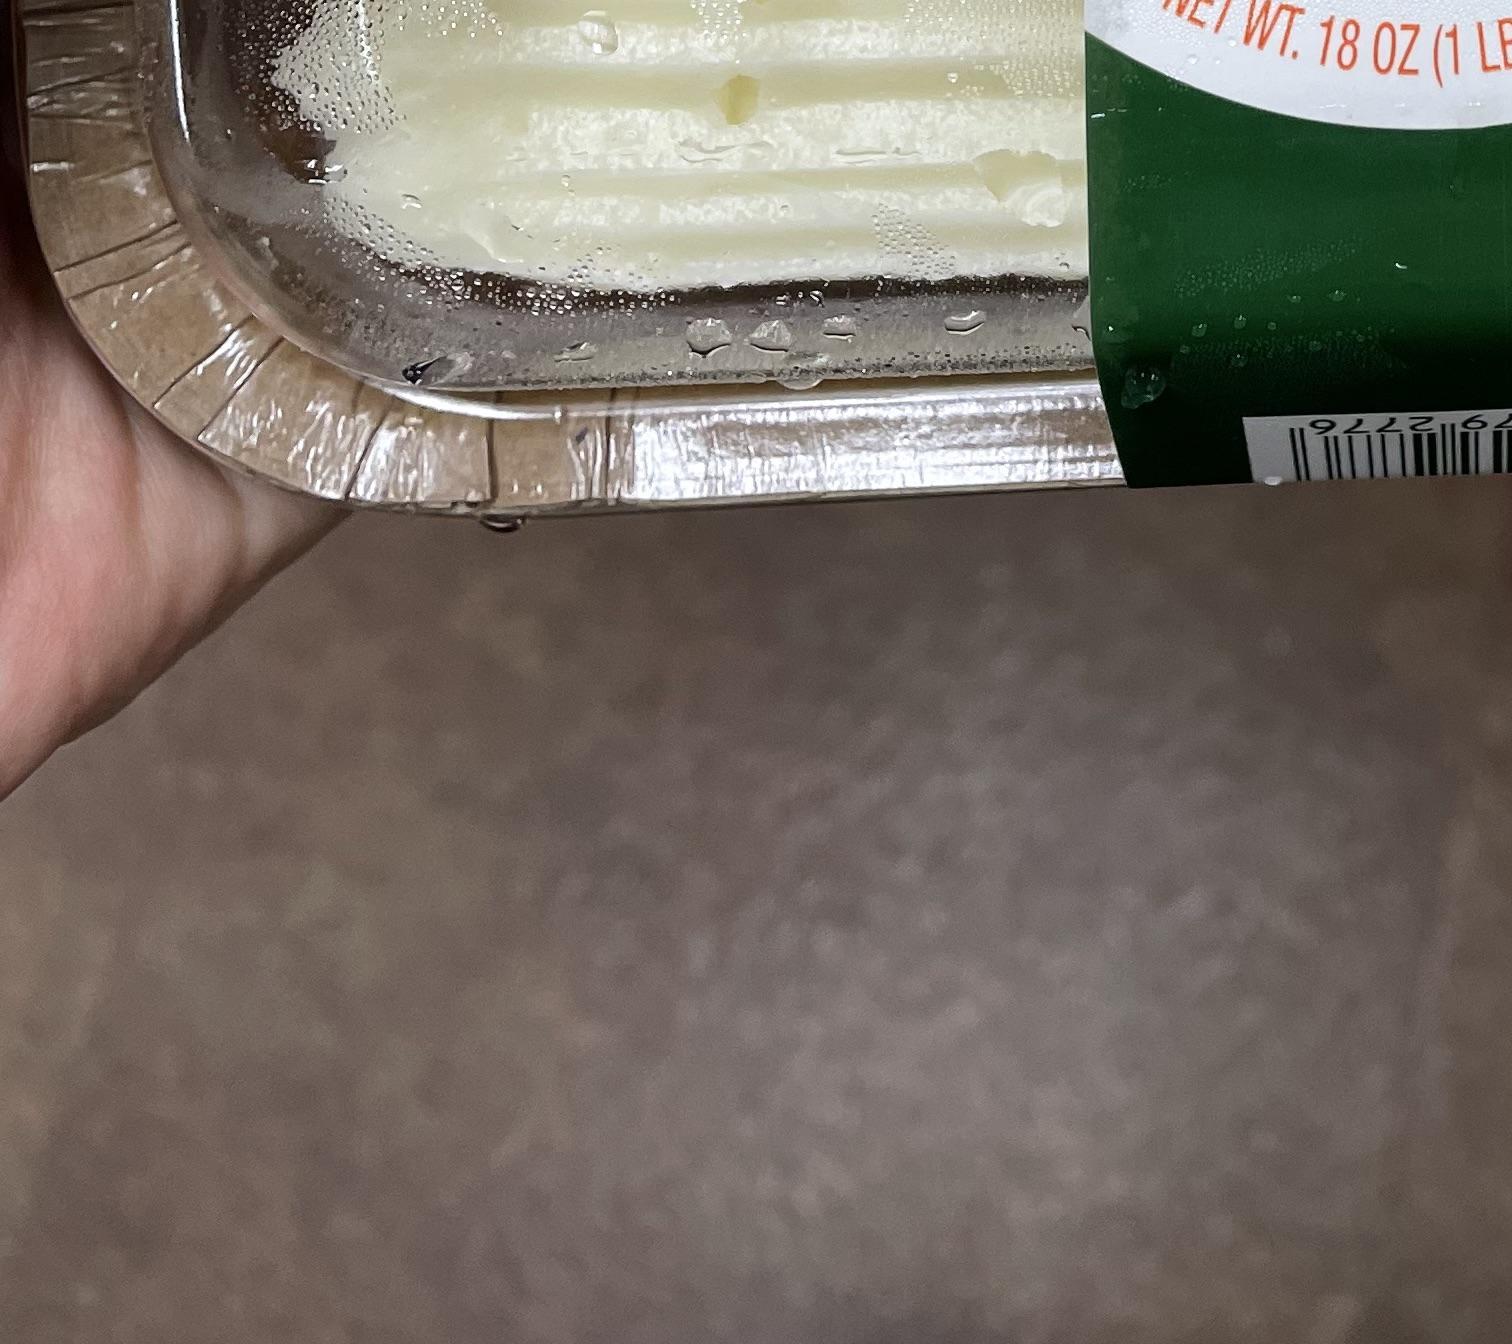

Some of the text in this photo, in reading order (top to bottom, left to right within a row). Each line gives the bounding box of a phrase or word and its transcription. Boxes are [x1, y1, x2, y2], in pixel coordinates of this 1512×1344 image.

[1320, 18, 1361, 71] 18
[1373, 21, 1420, 76] OZ
[1433, 22, 1461, 88] (1
[1308, 415, 1435, 436] 2776
